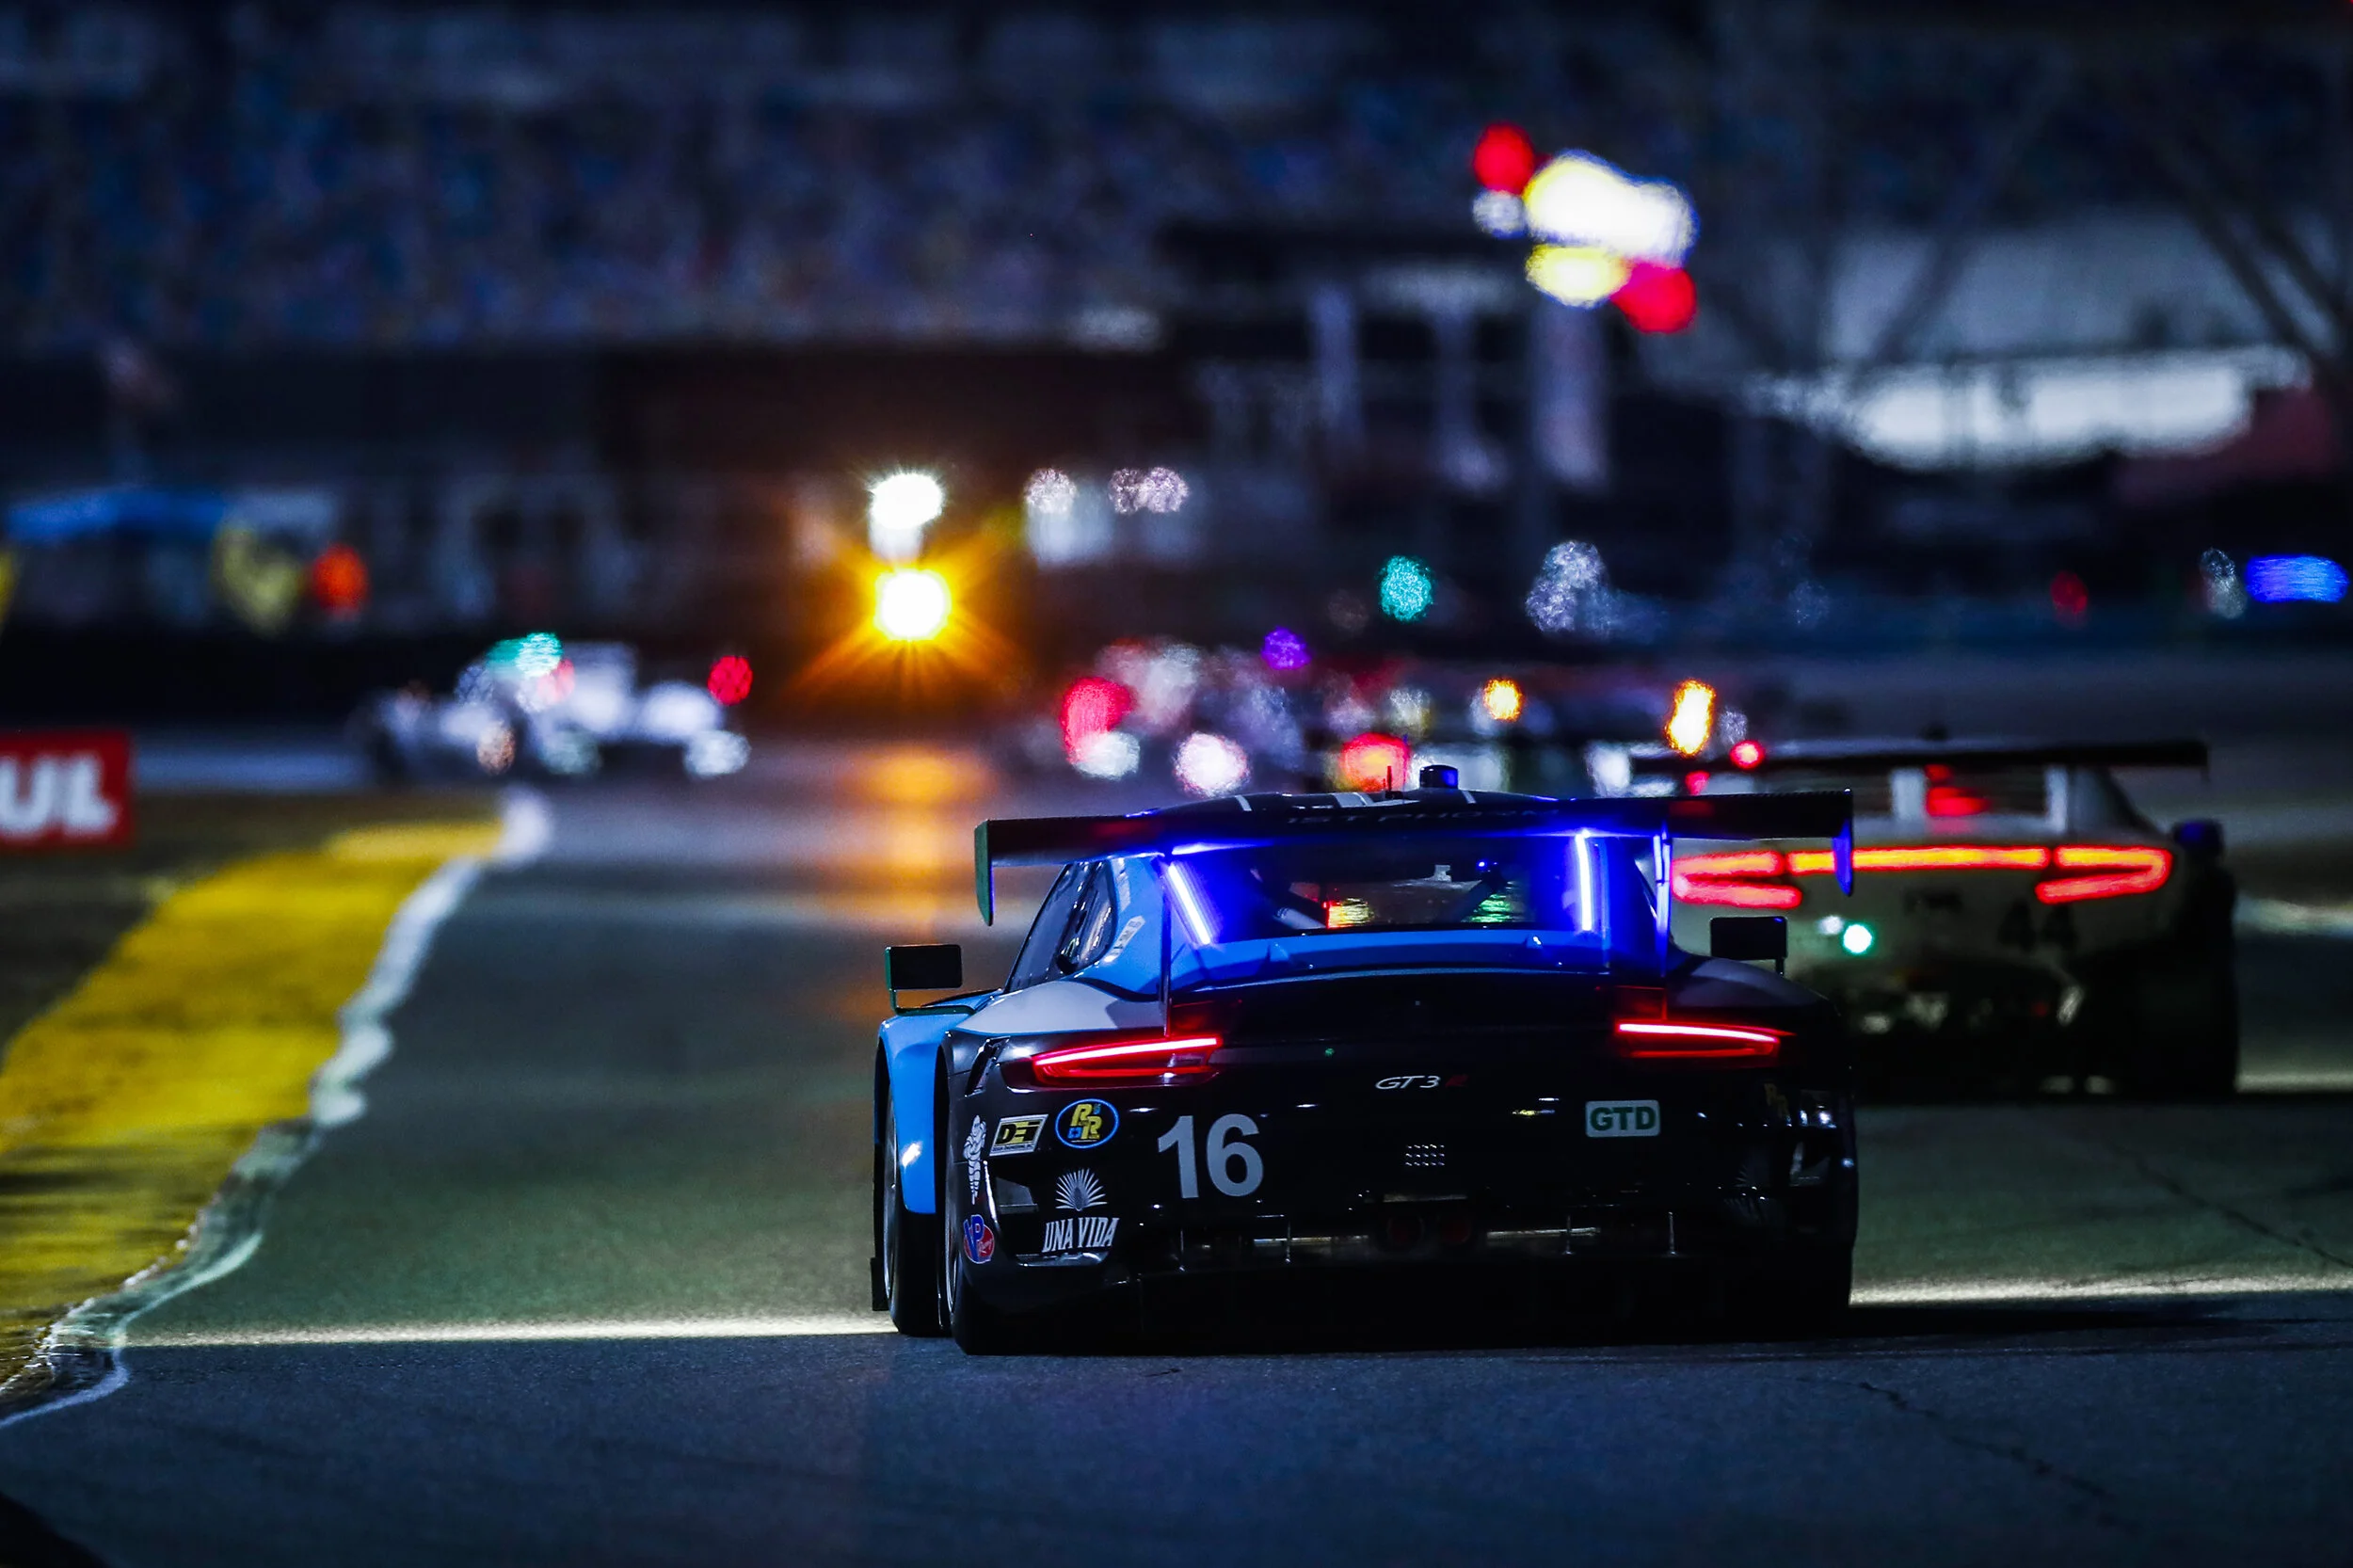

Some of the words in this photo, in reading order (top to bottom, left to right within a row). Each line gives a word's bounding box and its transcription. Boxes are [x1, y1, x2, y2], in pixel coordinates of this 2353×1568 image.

[1374, 1074, 1442, 1090] GT3
[1590, 1106, 1657, 1132] GTD
[1157, 1113, 1265, 1200] 16
[1041, 1217, 1074, 1253] UNA
[1076, 1216, 1121, 1248] VIDA
